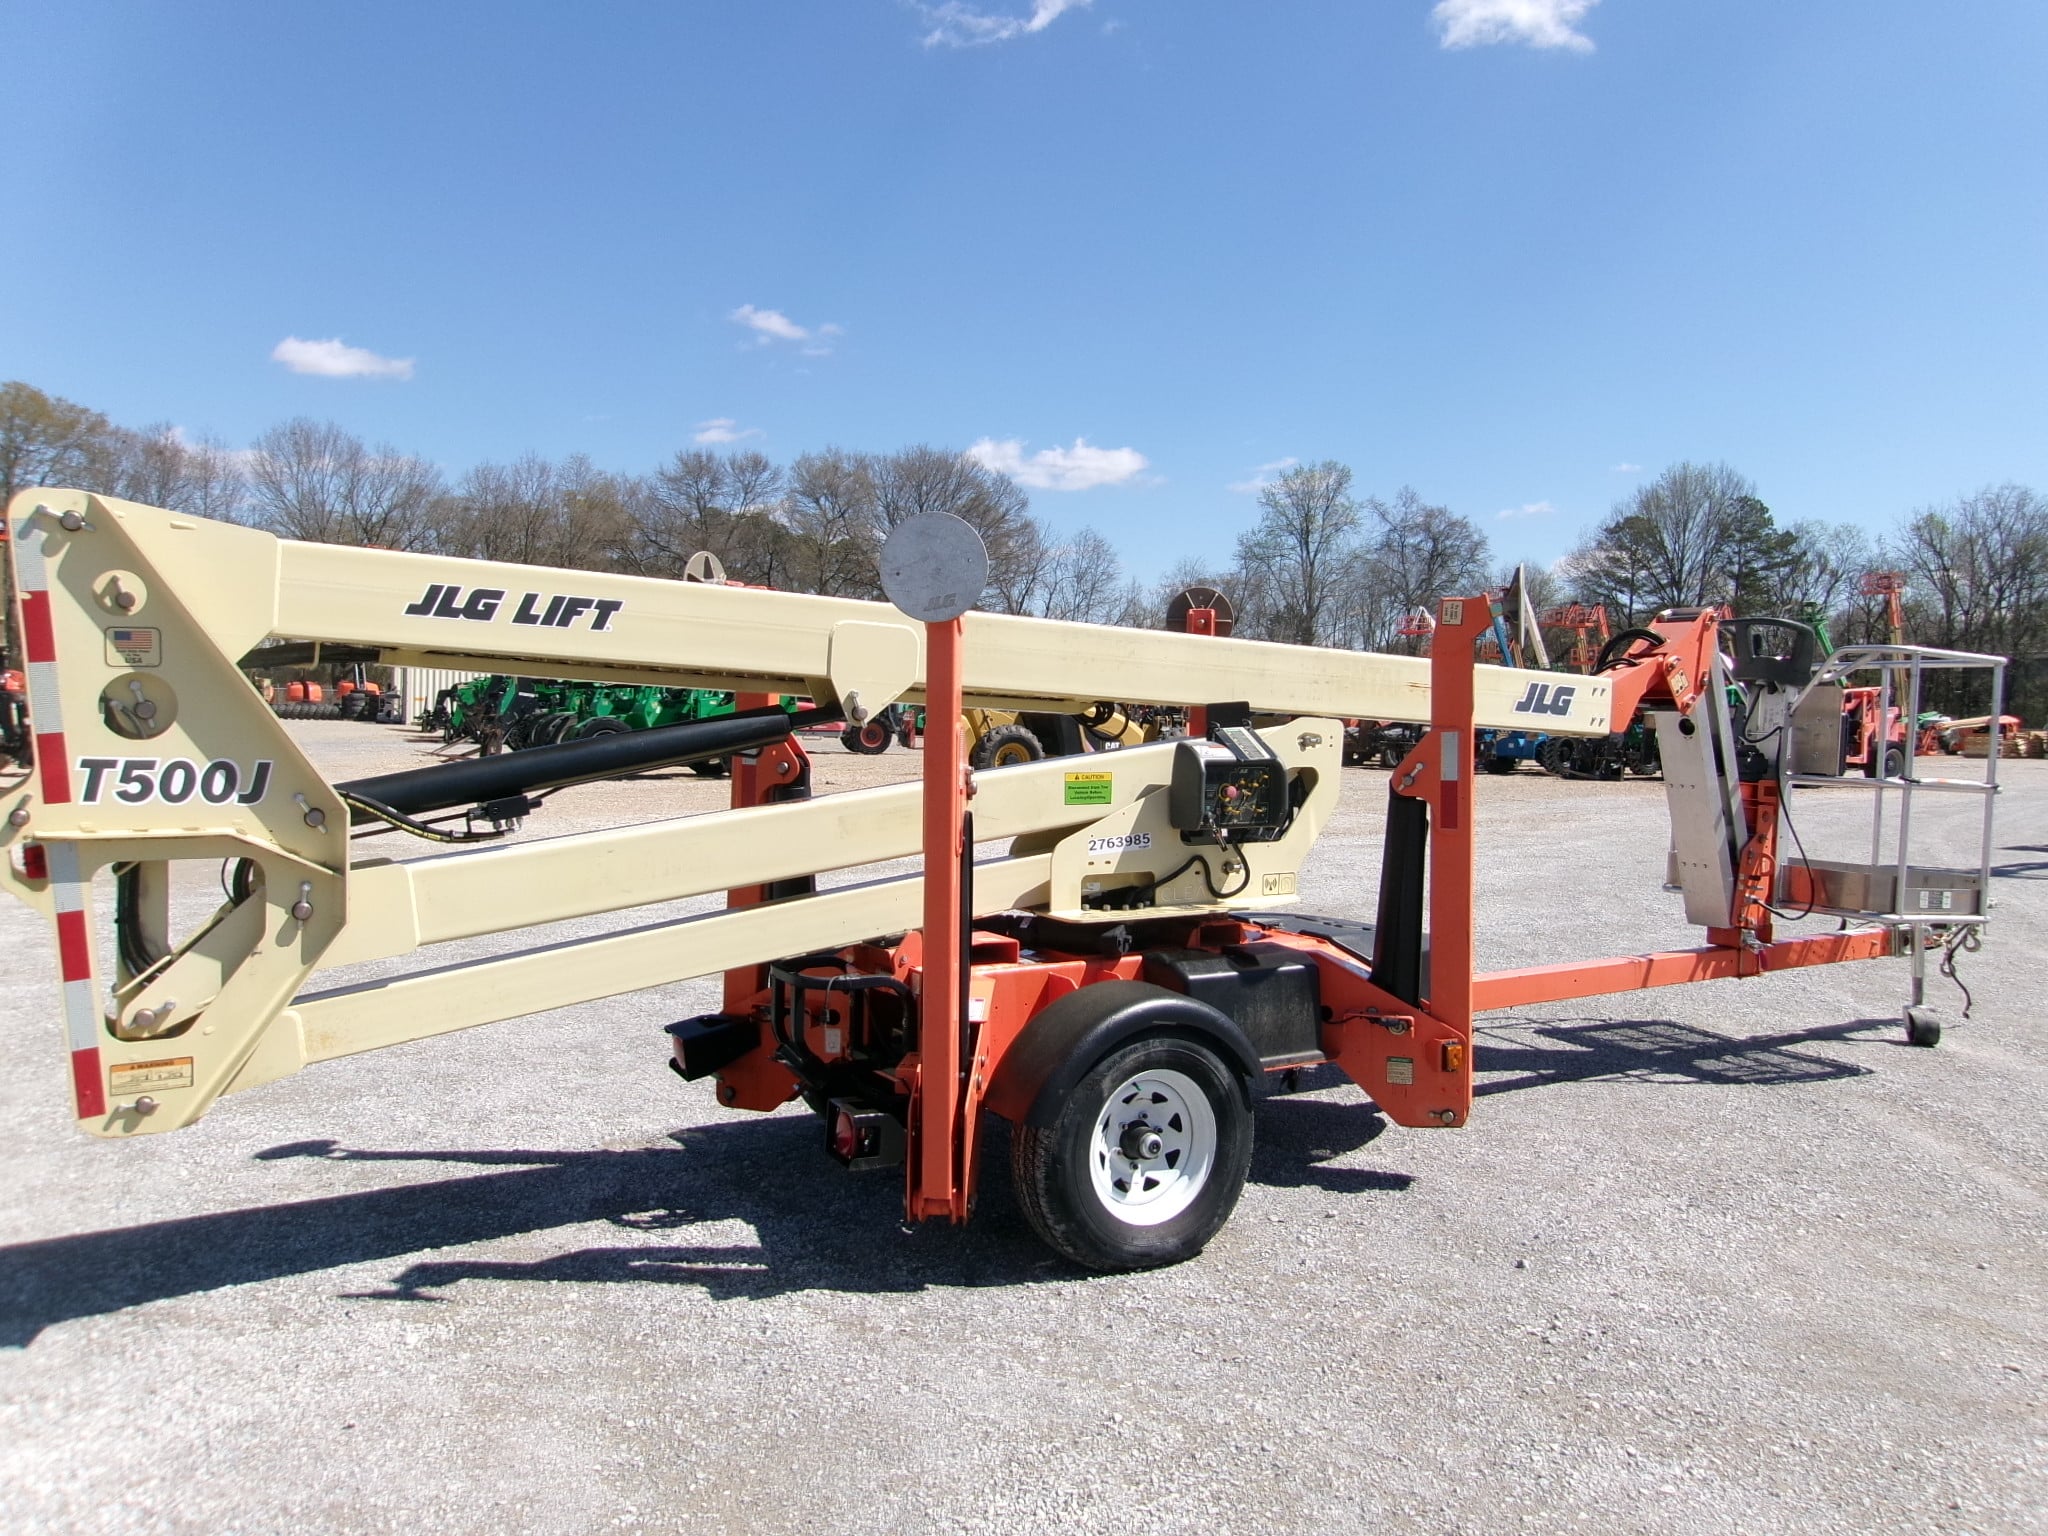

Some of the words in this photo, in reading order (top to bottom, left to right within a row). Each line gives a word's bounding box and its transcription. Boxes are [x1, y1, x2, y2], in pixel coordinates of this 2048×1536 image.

[403, 583, 507, 622] JLG
[510, 592, 625, 632] LIFT
[1514, 681, 1577, 717] JLG
[1105, 741, 1120, 750] CAT
[77, 757, 273, 805] T500J
[1088, 832, 1151, 851] 2763985
